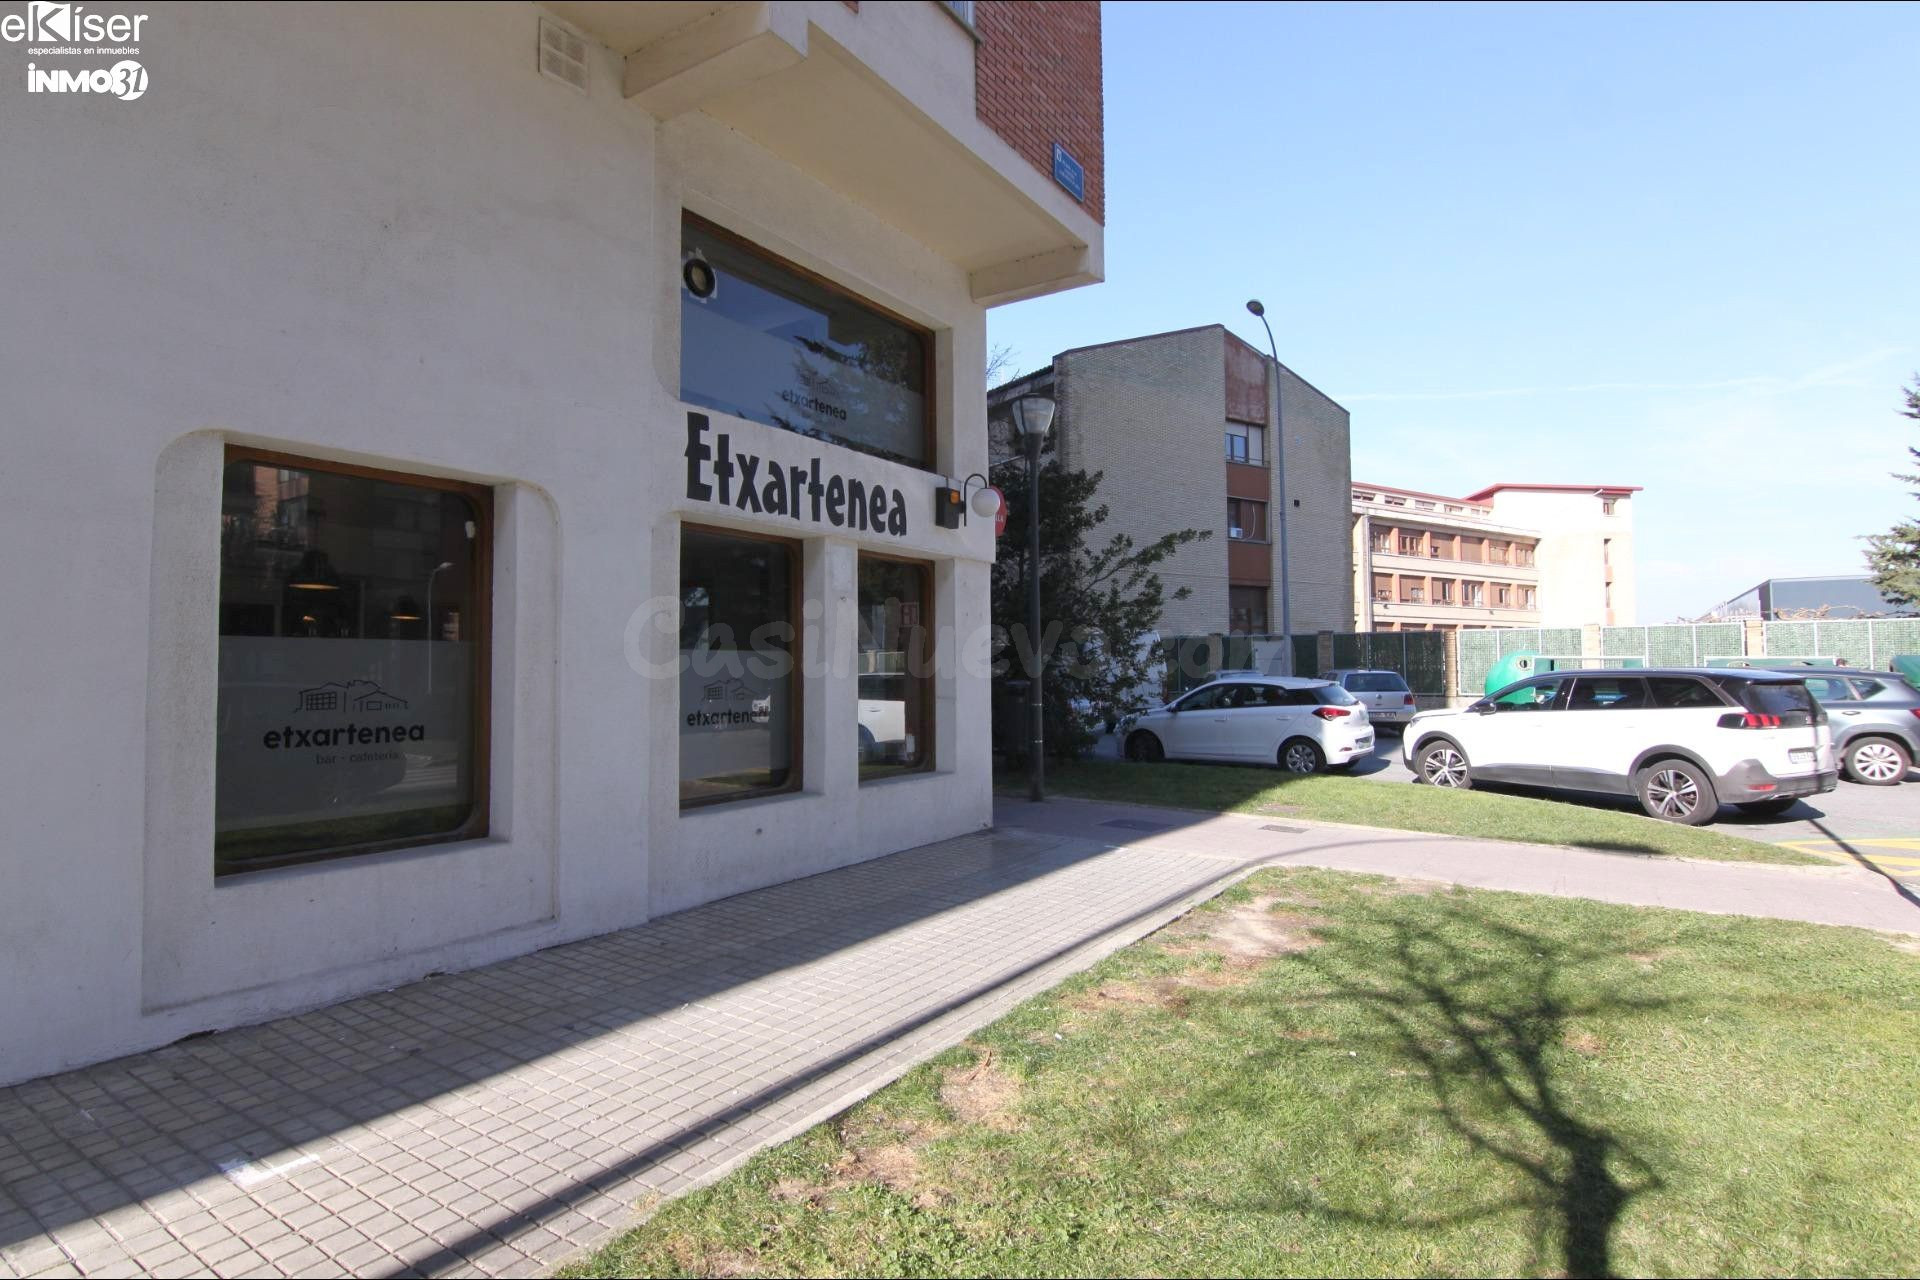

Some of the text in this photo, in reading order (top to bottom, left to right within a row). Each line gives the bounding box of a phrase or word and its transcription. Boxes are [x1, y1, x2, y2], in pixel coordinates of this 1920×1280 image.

[781, 389, 847, 421] etxartenea
[684, 411, 907, 537] Etxartenea
[263, 723, 425, 749] etxartenea
